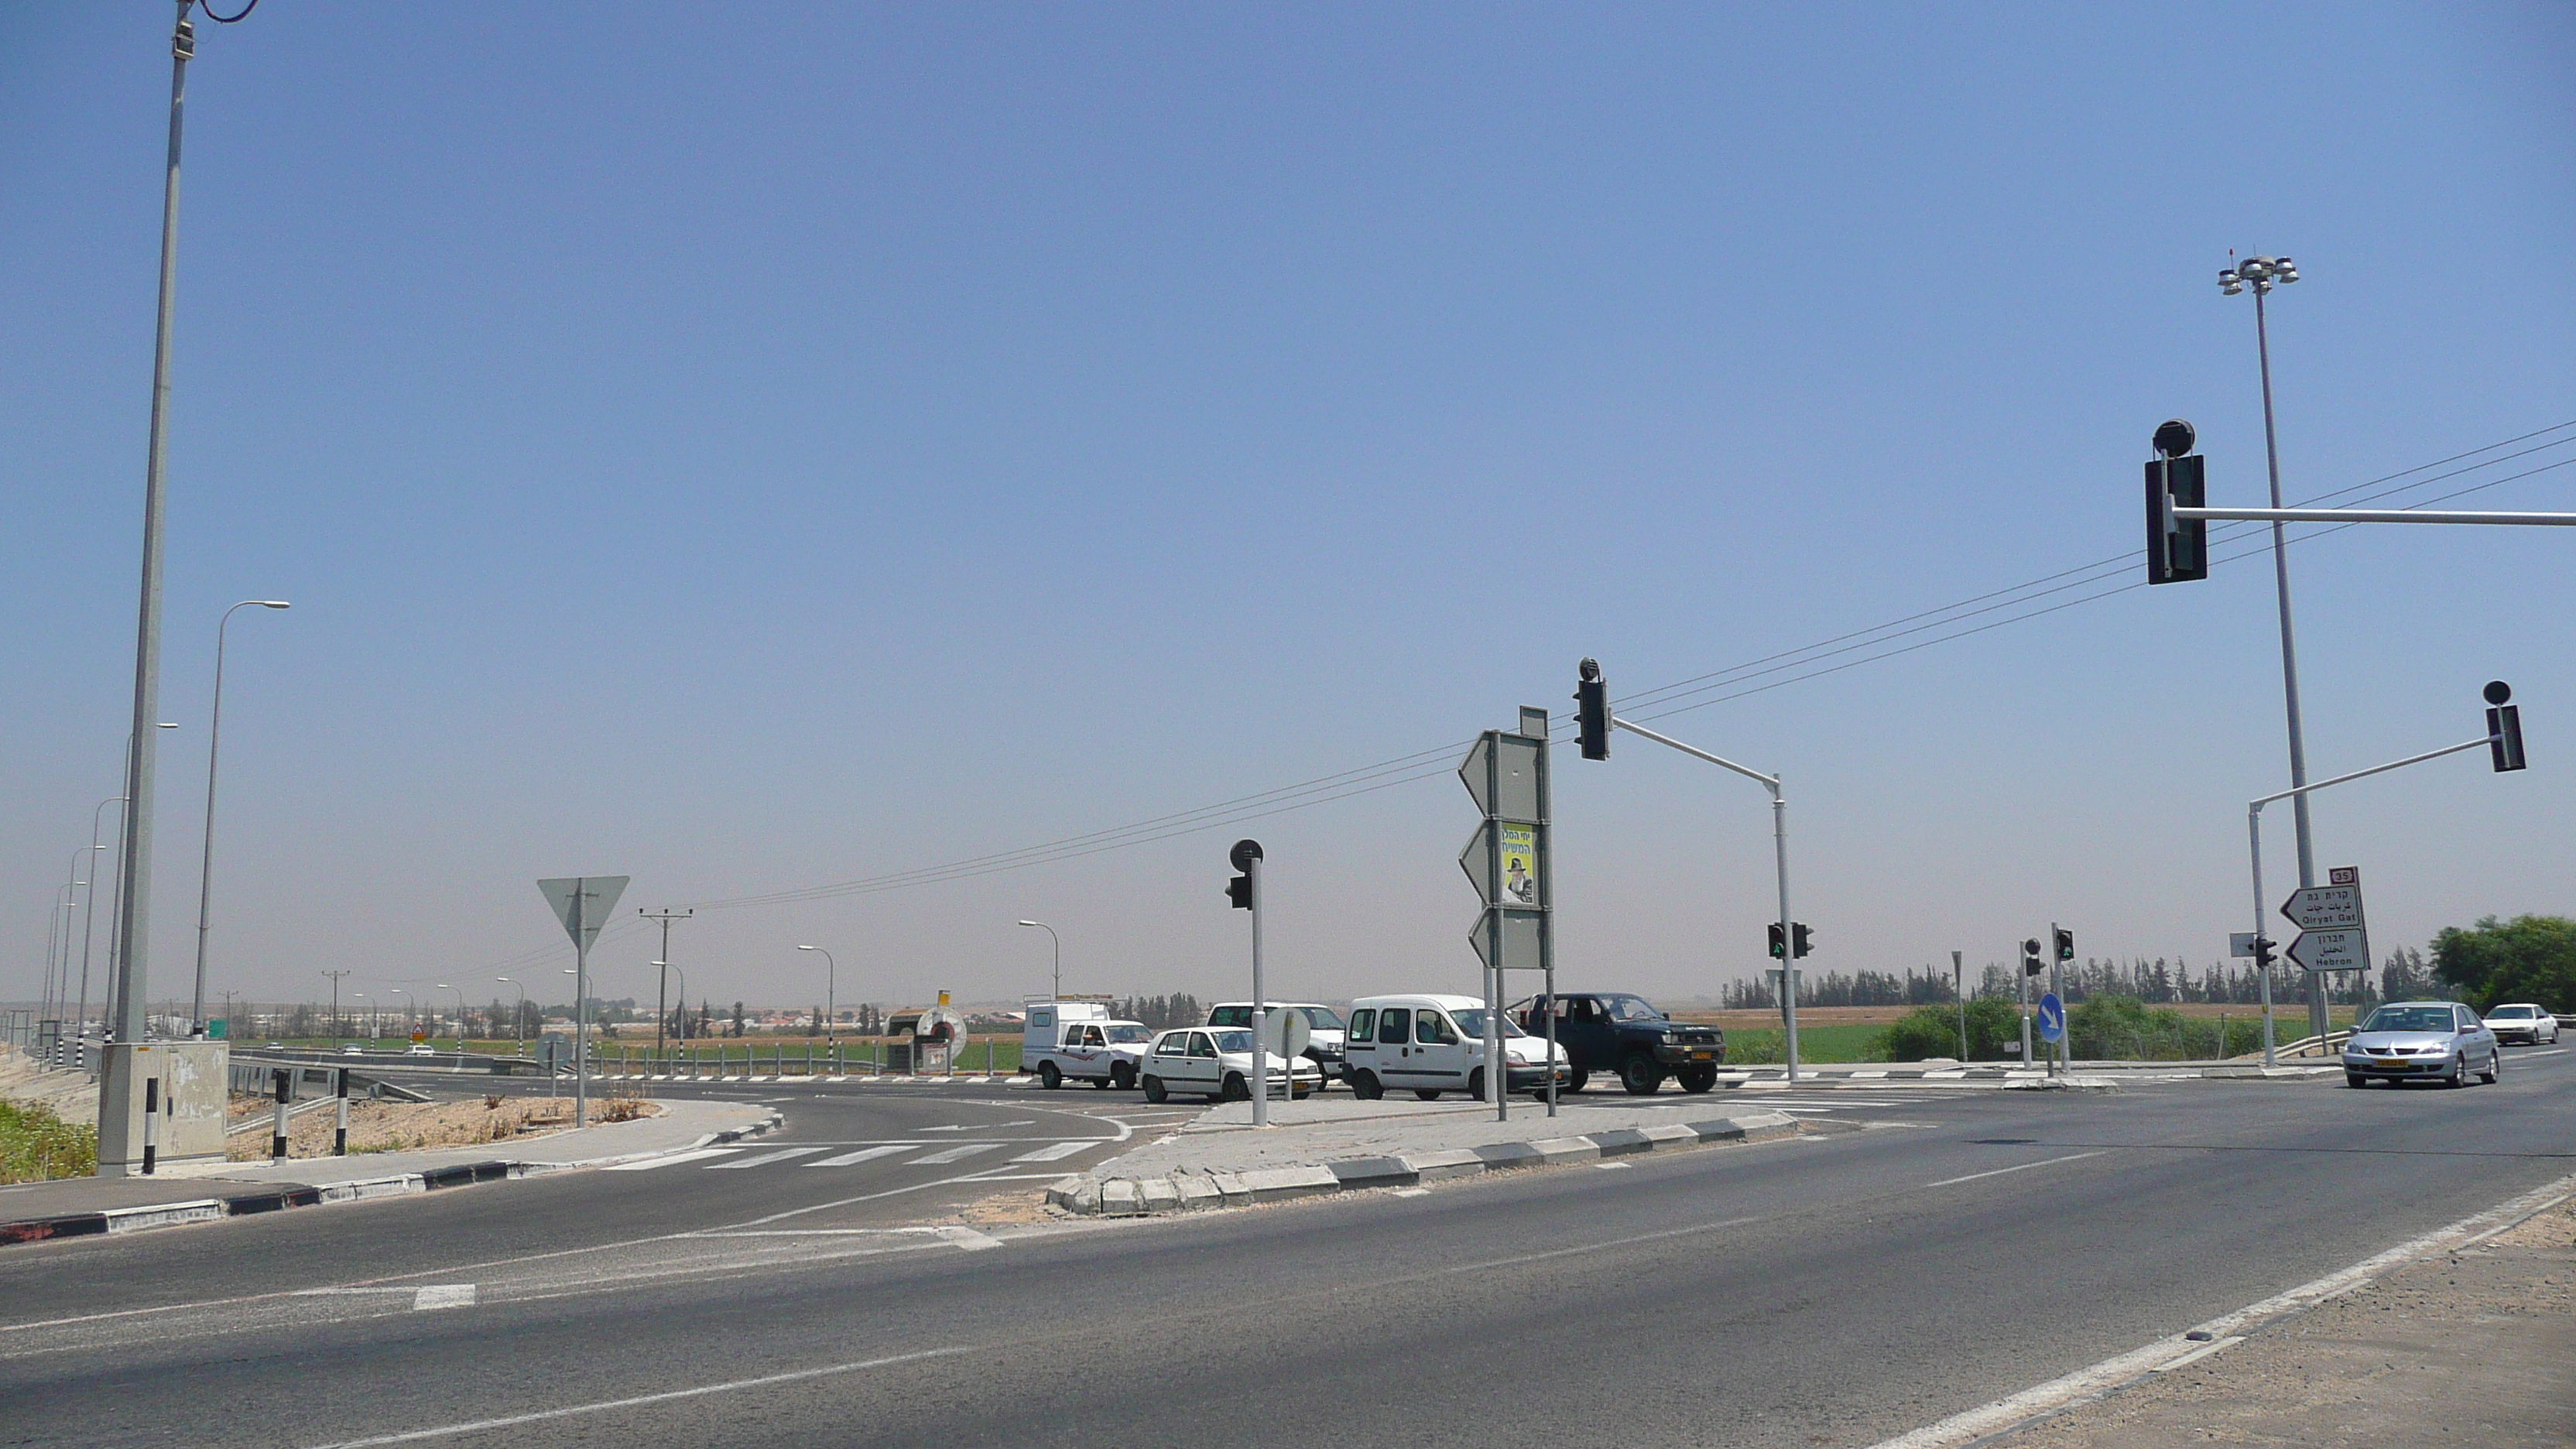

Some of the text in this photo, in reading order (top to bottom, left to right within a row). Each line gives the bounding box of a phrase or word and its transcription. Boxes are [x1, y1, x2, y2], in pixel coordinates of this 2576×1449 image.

[1520, 832, 1530, 841] יחי
[1502, 842, 1530, 855] המשיח
[2335, 872, 2349, 881] 35
[2307, 891, 2348, 901] קרית גת
[2302, 913, 2355, 925] Qiryat Gat
[2317, 934, 2345, 944] חברון
[2316, 957, 2352, 966] Hebron
